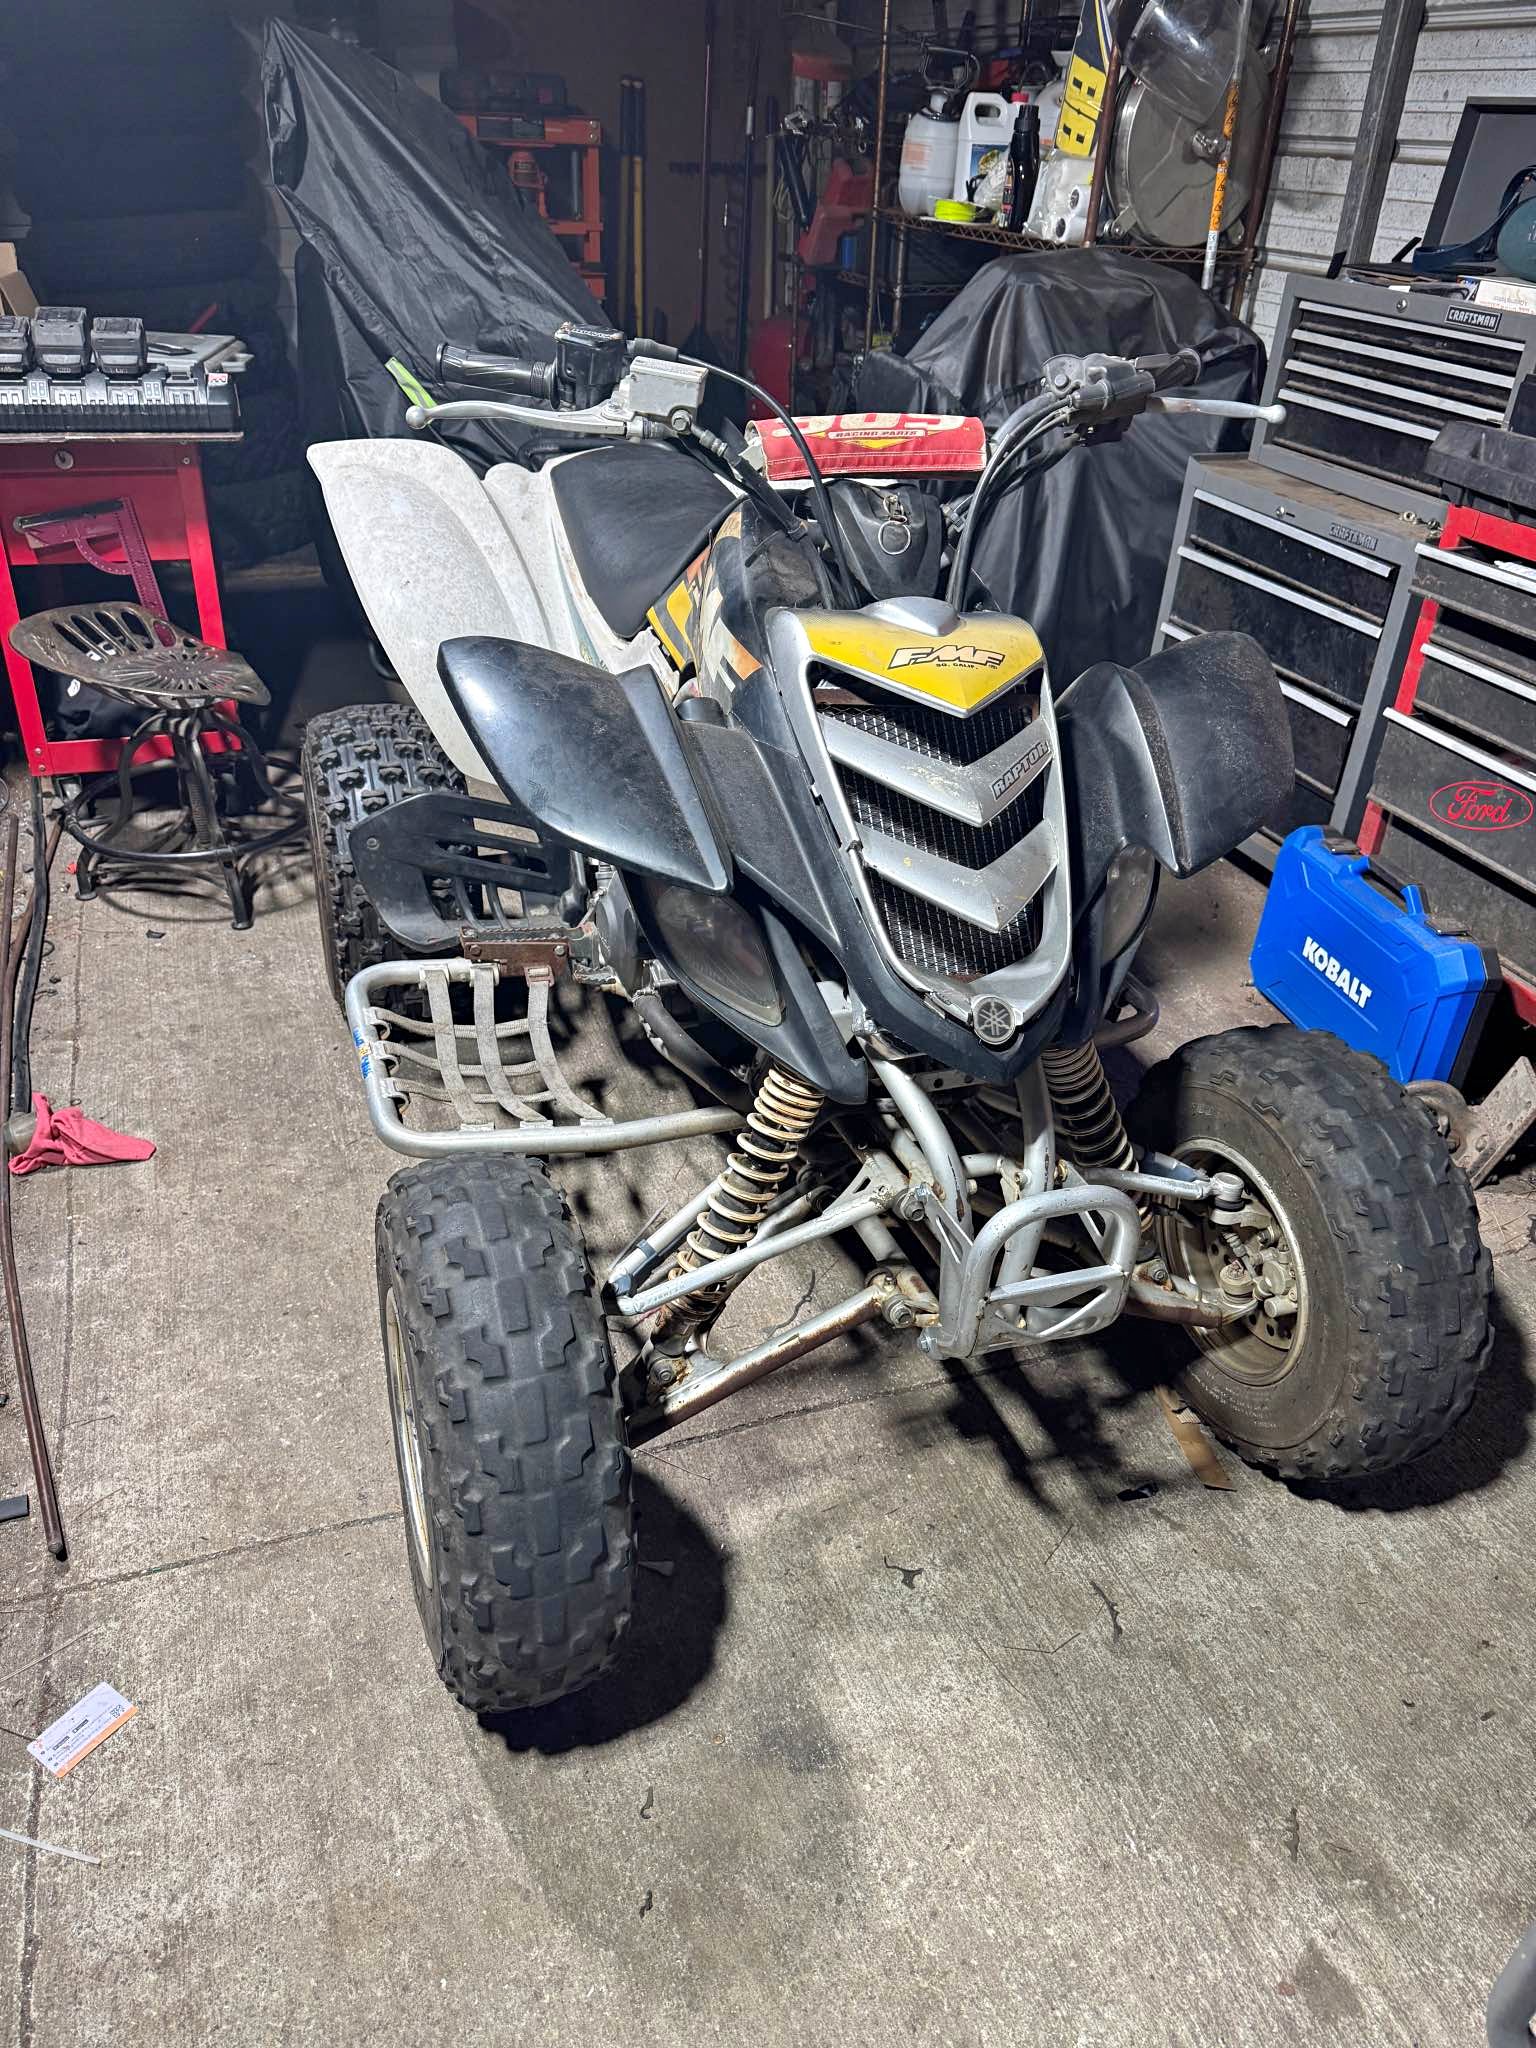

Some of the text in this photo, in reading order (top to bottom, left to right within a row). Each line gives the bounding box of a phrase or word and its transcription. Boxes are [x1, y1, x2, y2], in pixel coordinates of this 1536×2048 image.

[1448, 309, 1496, 328] CRAFTSMAN
[1328, 522, 1379, 551] CRAFTSMAN
[887, 644, 1006, 670] FMF
[991, 740, 1050, 801] RAPTOR
[1447, 785, 1513, 824] Ford
[1301, 936, 1373, 1009] KOBALT
